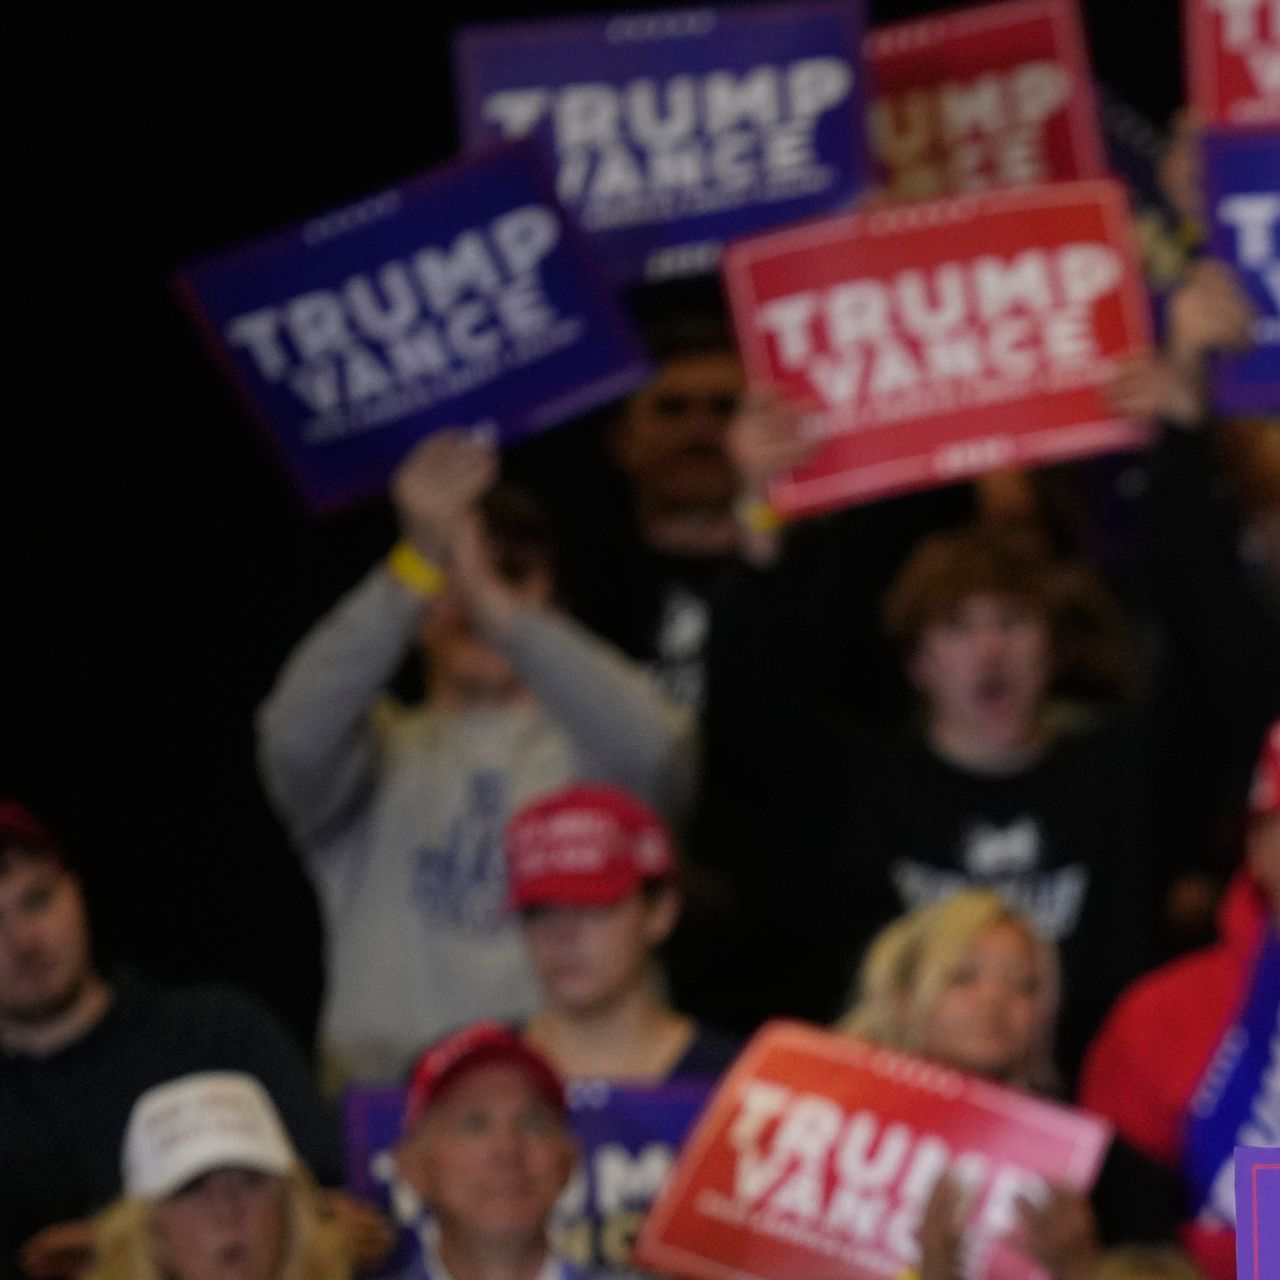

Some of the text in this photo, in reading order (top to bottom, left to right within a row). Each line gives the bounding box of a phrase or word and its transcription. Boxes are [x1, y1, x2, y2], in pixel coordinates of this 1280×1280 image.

[228, 205, 560, 381] TRUMP
[757, 243, 1123, 371] TRUMP
[806, 308, 1096, 412] VANCE
